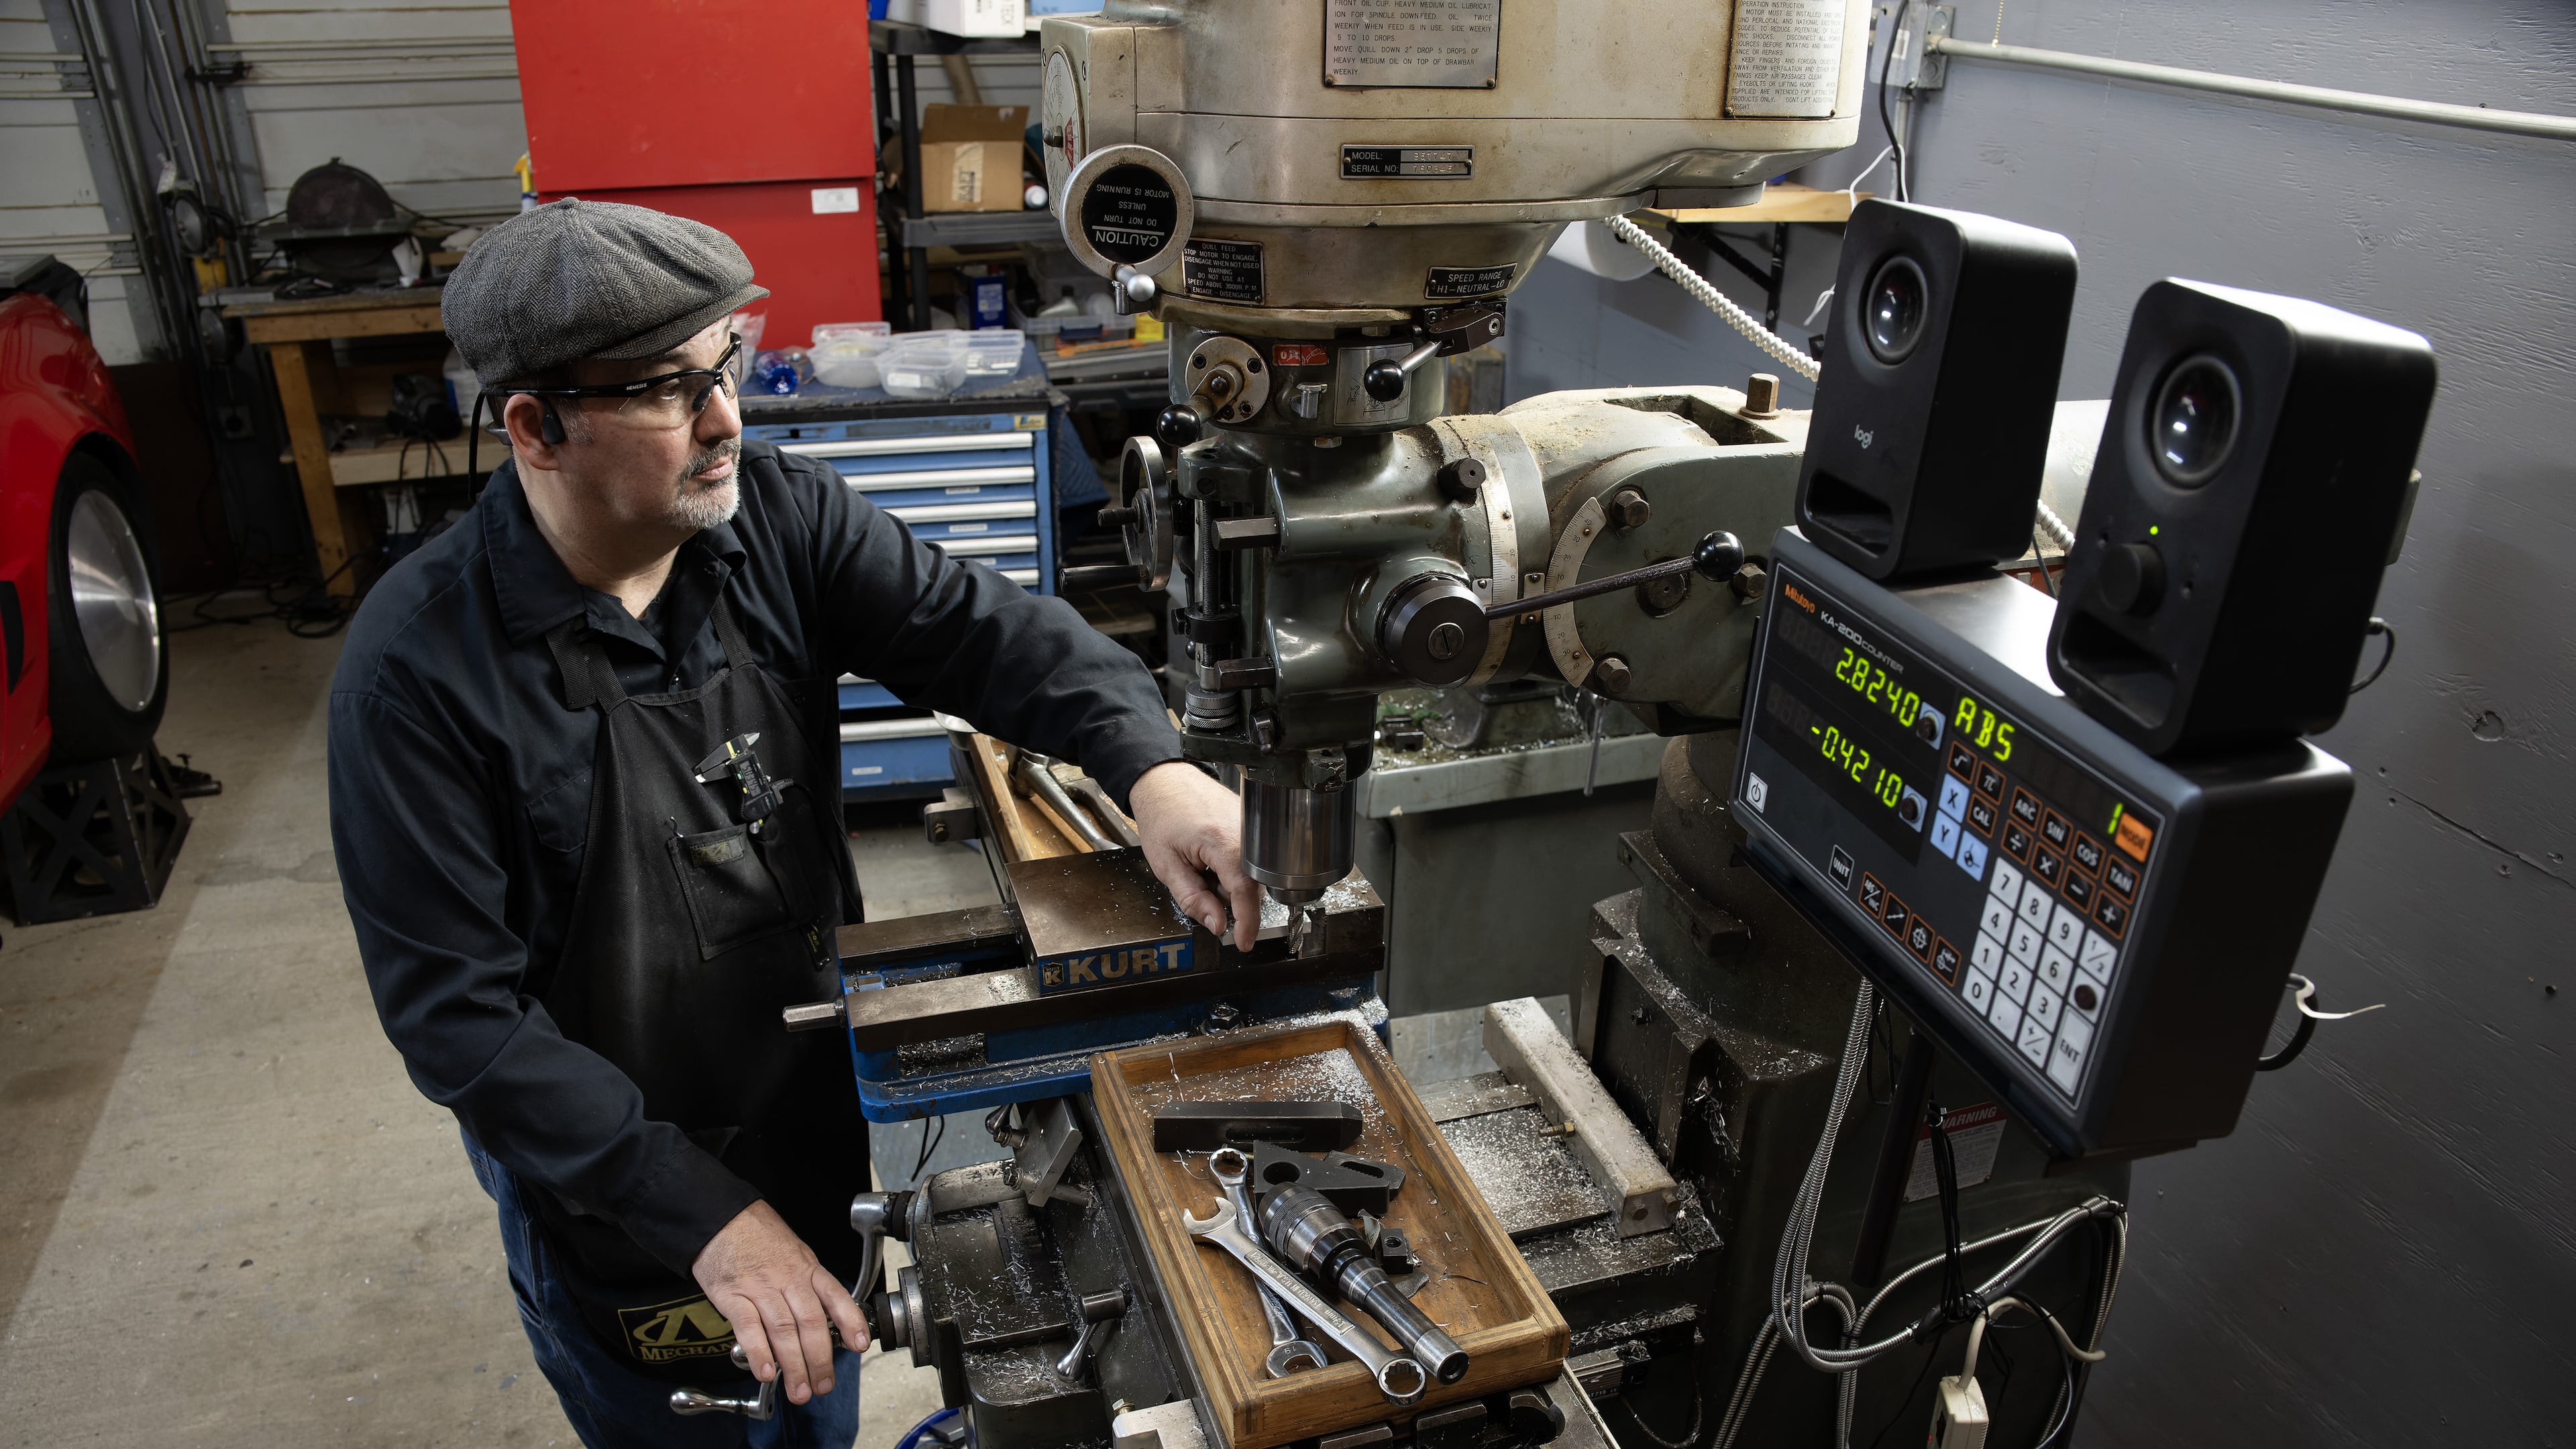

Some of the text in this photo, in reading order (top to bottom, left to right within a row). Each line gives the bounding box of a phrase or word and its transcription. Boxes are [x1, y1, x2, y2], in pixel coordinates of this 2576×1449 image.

[1358, 46, 1376, 54] QUILL
[1352, 152, 1383, 160] MODEL:
[1351, 165, 1379, 173] SERIAL
[1385, 165, 1399, 173] NO:
[1096, 184, 1169, 199] MOTOR IS RUNNING
[1119, 201, 1146, 211] UNLESS
[1104, 215, 1157, 227] DO NOT TURN
[1095, 231, 1159, 247] CAUTION
[1202, 243, 1218, 251] QUILL
[1185, 256, 1212, 266] DISENGAGE
[1208, 267, 1233, 276] WARNING
[1448, 271, 1503, 282] SPEED RANGE
[1187, 278, 1203, 286] SPEED
[1193, 287, 1251, 299] ENGAGE DISENGAGE
[627, 382, 647, 390] NEMESIS
[1854, 424, 1874, 449] logi
[1585, 519, 1593, 527] 40
[1572, 535, 1580, 543] 30
[1509, 549, 1515, 557] 20
[1784, 584, 1816, 614] Mitutoyo
[1821, 610, 1904, 674] KA-200 COUNTER
[1563, 648, 1571, 656] 30
[1572, 663, 1580, 671] 40
[1835, 647, 1921, 728] 2.8240
[1955, 696, 2015, 761] ABS
[1811, 725, 1902, 808] -0.4210
[1948, 794, 1959, 809] X
[2014, 798, 2037, 821] ARC
[1972, 806, 1990, 828] CAL
[2108, 802, 2124, 835] 1
[1941, 824, 1950, 843] Y
[2046, 820, 2065, 843] SIN
[2076, 843, 2098, 867] COS
[1833, 857, 1850, 877] UNIT
[1864, 879, 1875, 894] ABS
[2000, 873, 2010, 891] 7
[2110, 867, 2133, 893] TAN
[1868, 898, 1880, 912] INC
[2029, 898, 2039, 916] 8
[1991, 912, 2000, 928] 4
[2059, 922, 2071, 940] 9
[2019, 935, 2030, 952] 5
[1068, 943, 1186, 985] KURT
[1983, 948, 1990, 964] 1
[1045, 970, 1061, 985] K
[2049, 961, 2060, 979] 6
[2008, 971, 2019, 989] 2
[1972, 982, 1982, 999] 0
[2038, 996, 2049, 1015] 3
[2059, 1038, 2081, 1063] ENT
[1284, 1346, 1297, 1354] 19
